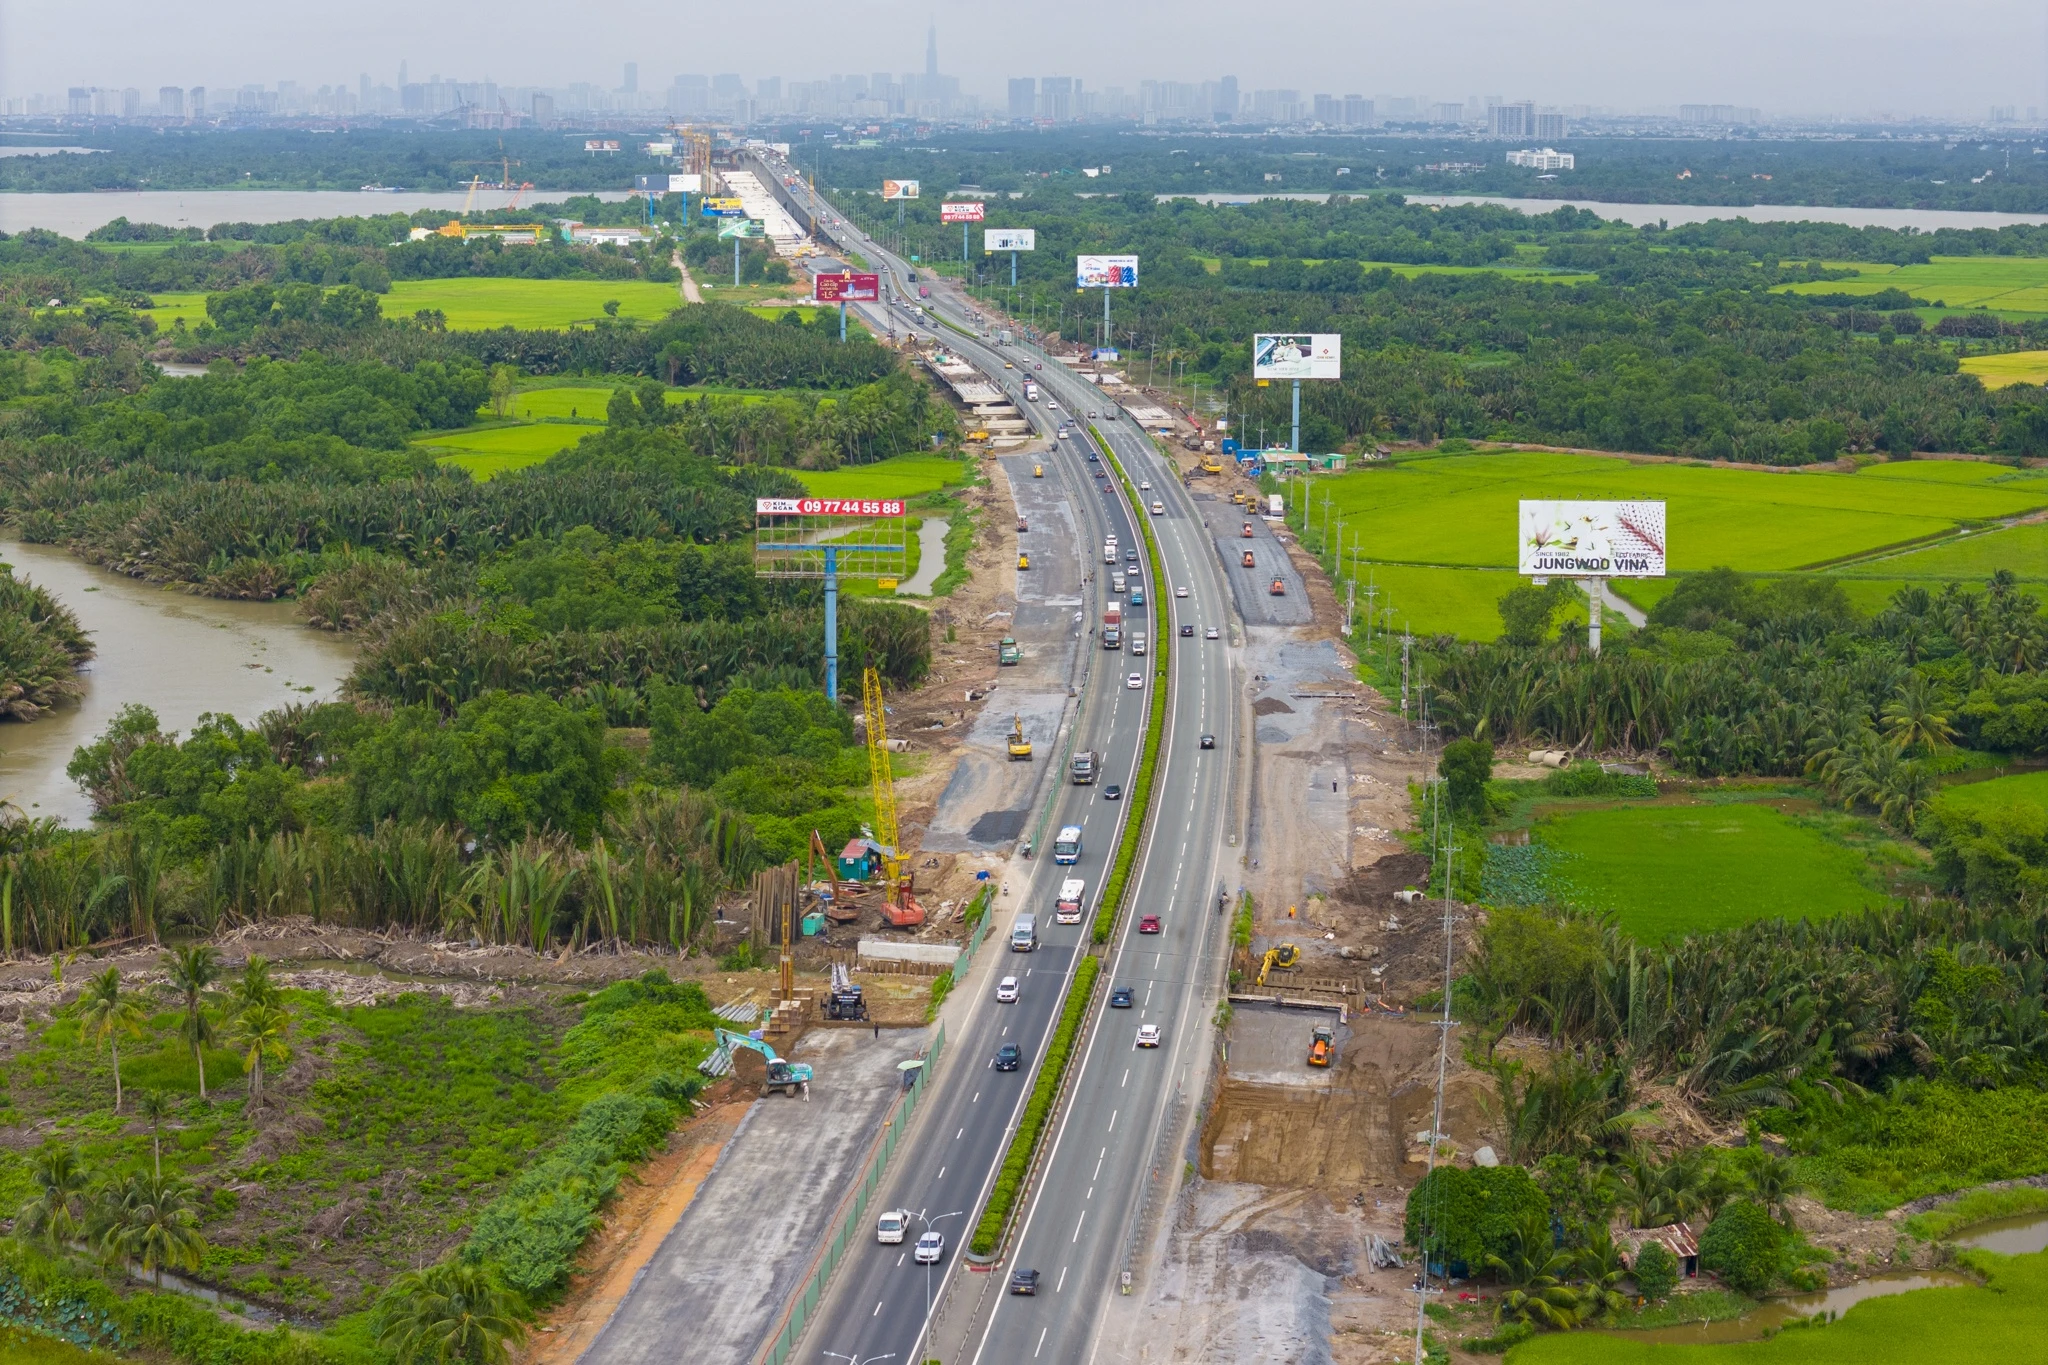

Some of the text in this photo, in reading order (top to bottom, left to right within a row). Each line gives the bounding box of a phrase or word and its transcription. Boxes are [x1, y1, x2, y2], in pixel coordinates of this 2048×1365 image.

[804, 501, 900, 514] 09 77 44 55 88
[1533, 558, 1649, 570] JUNGWOO VINA
